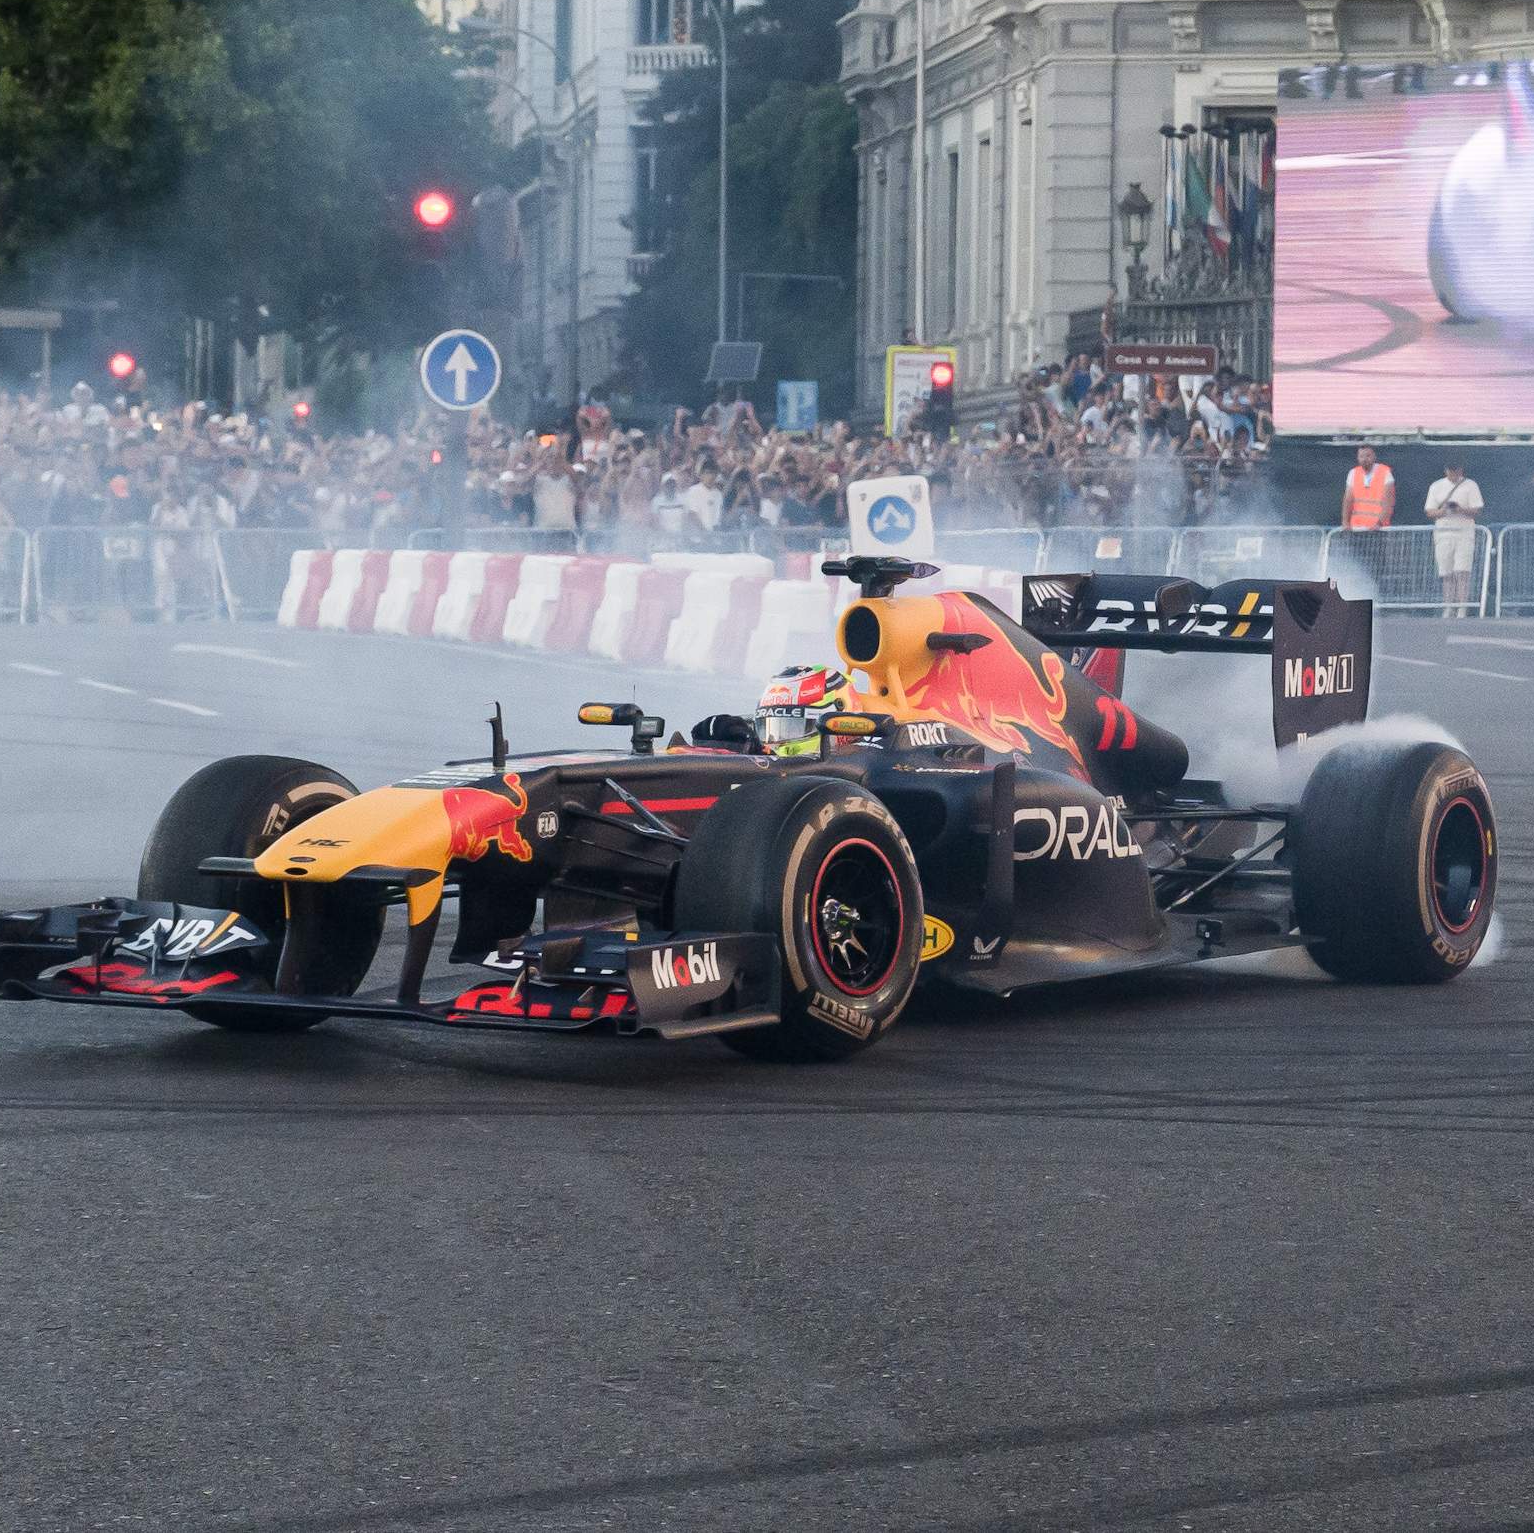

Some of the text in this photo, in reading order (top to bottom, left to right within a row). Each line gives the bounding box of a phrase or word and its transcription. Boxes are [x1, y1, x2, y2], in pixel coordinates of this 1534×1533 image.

[1284, 656, 1337, 698] Mobil
[907, 722, 948, 746] ROKT
[1095, 695, 1138, 752] 11
[538, 817, 557, 834] FIA
[297, 837, 352, 848] HRC
[651, 941, 721, 989] Mobil
